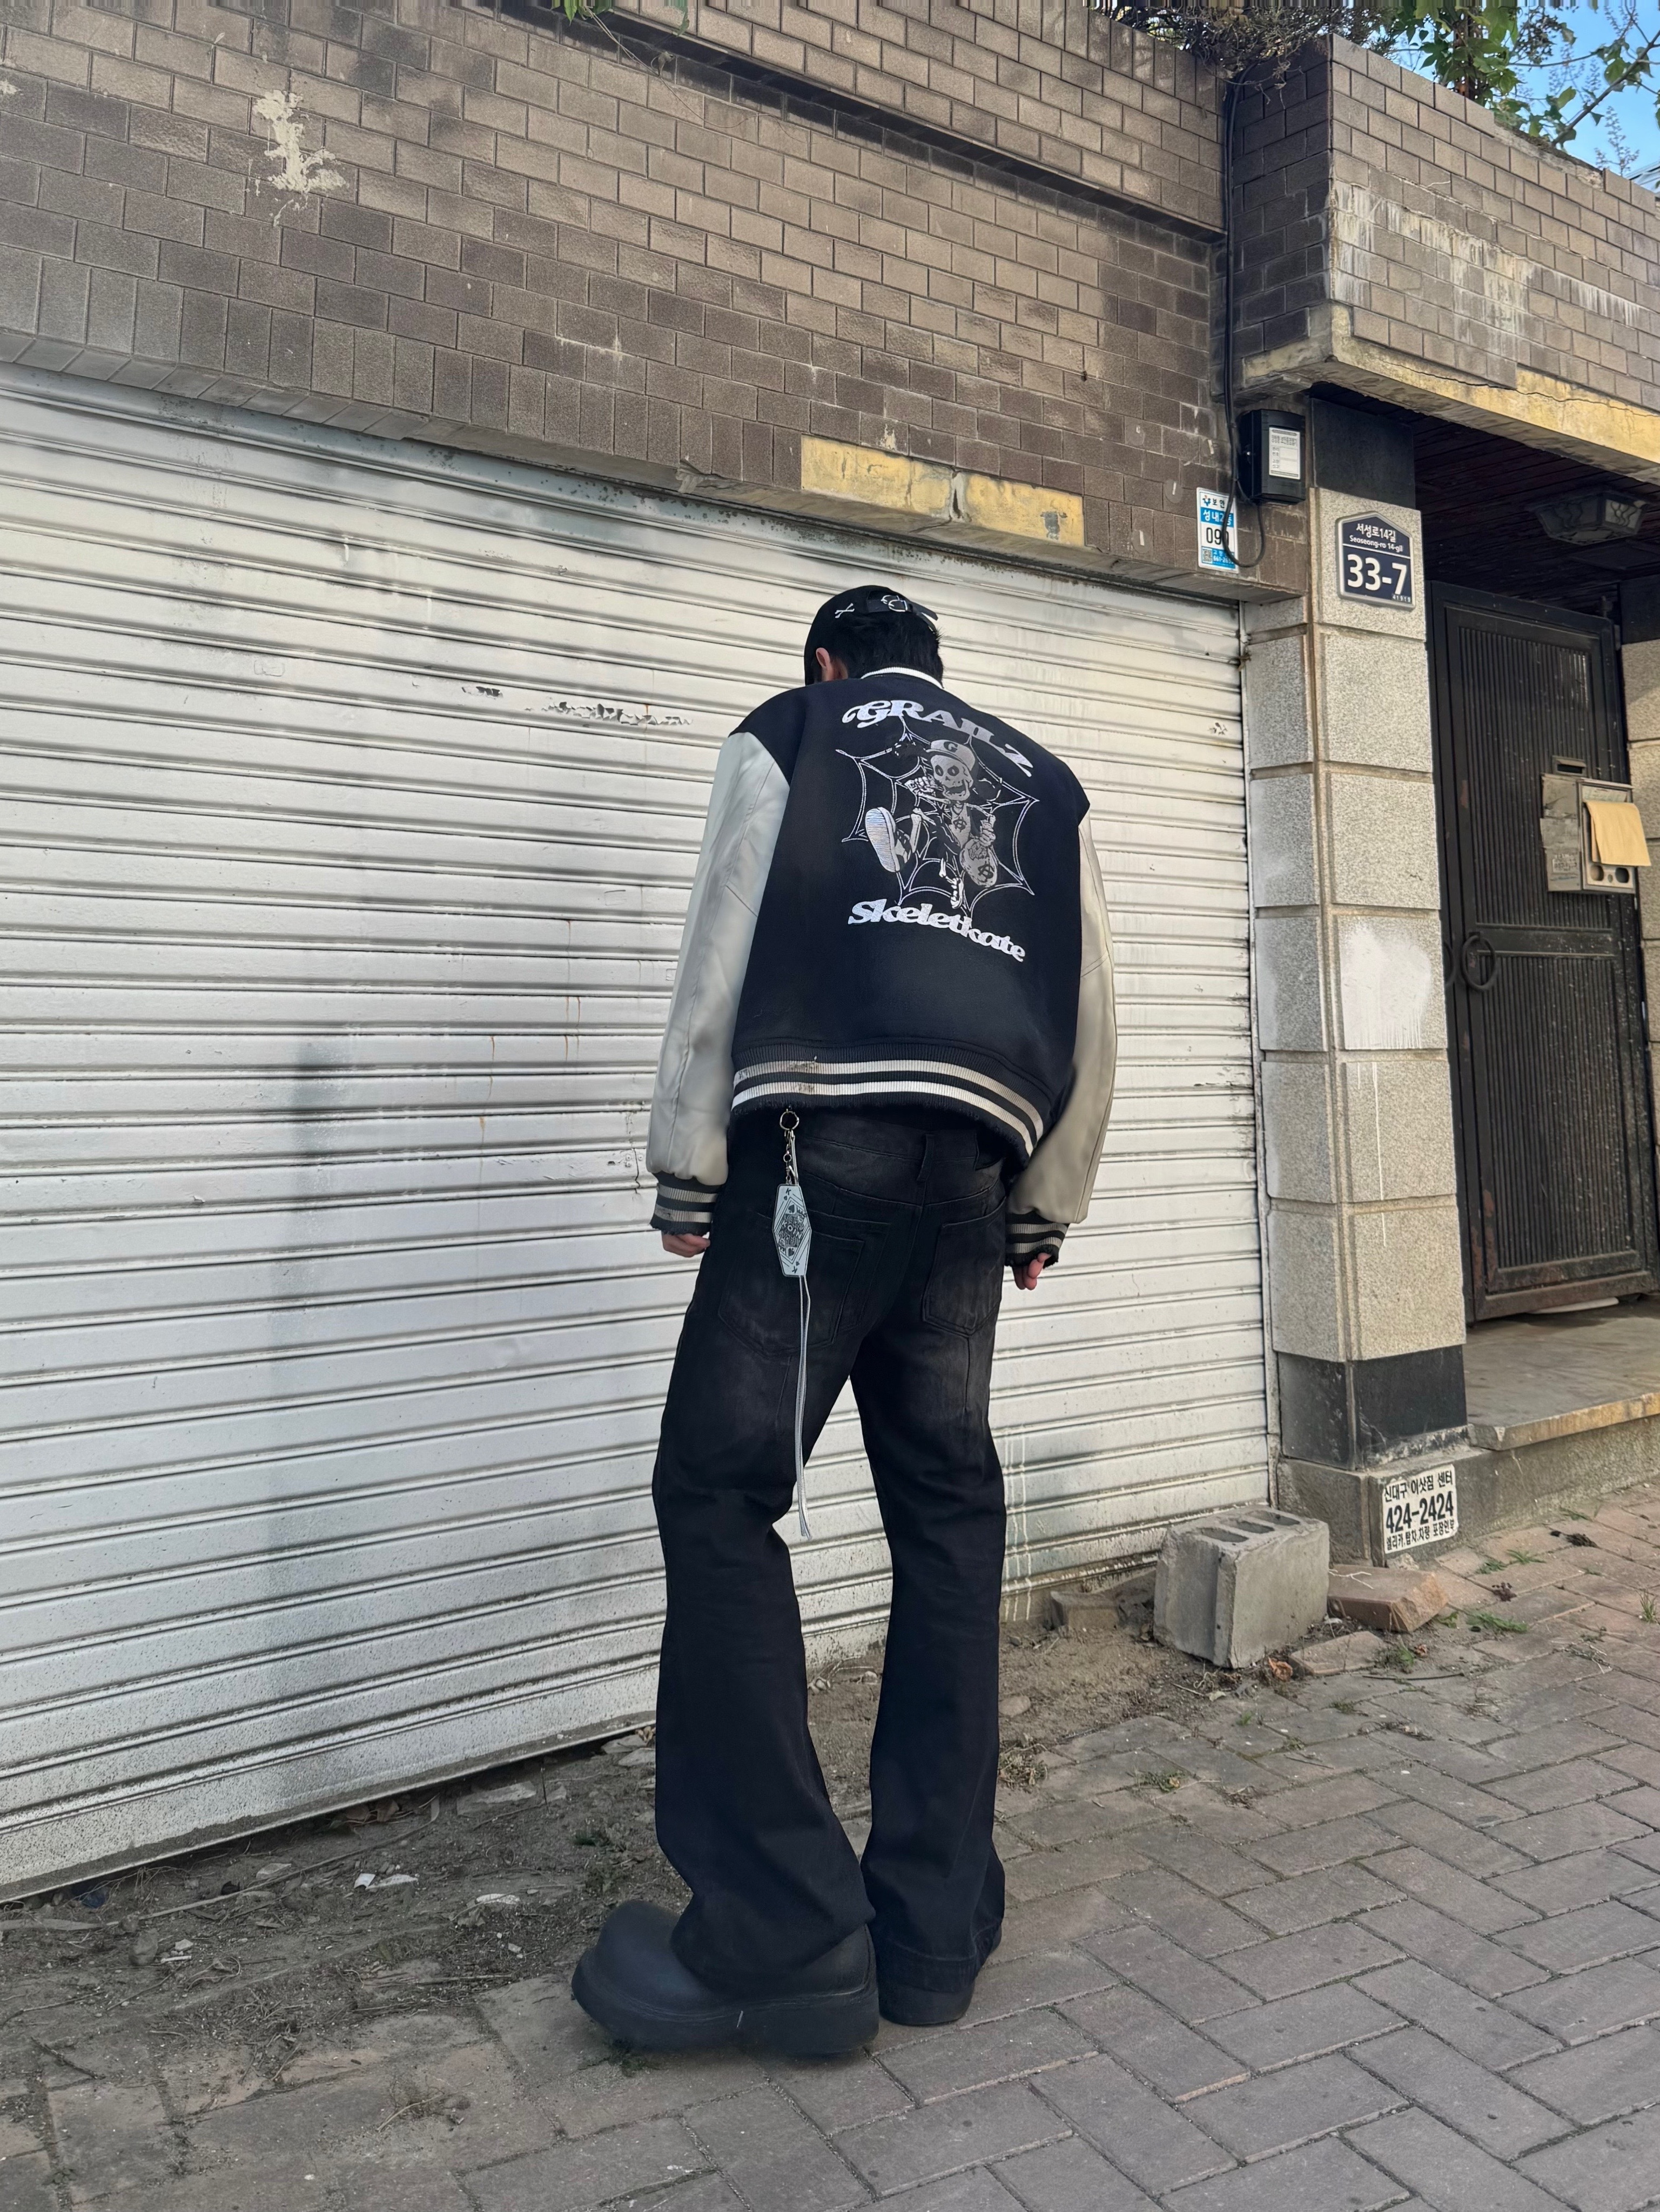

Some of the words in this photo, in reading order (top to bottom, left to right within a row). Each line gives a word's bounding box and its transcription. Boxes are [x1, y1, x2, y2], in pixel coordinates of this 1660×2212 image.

[1212, 498, 1225, 509] 보안
[1349, 535, 1386, 549] Seoseong-ro
[1387, 543, 1403, 553] 14-gil
[1356, 523, 1396, 543] 서성로14길
[1347, 554, 1407, 595] 33-7
[842, 699, 1034, 777] GRAILZ
[1385, 1482, 1408, 1503] 신대구
[1411, 1474, 1434, 1495] 이삿짐
[1437, 1470, 1453, 1488] 센터
[1386, 1491, 1454, 1534] 424-2424
